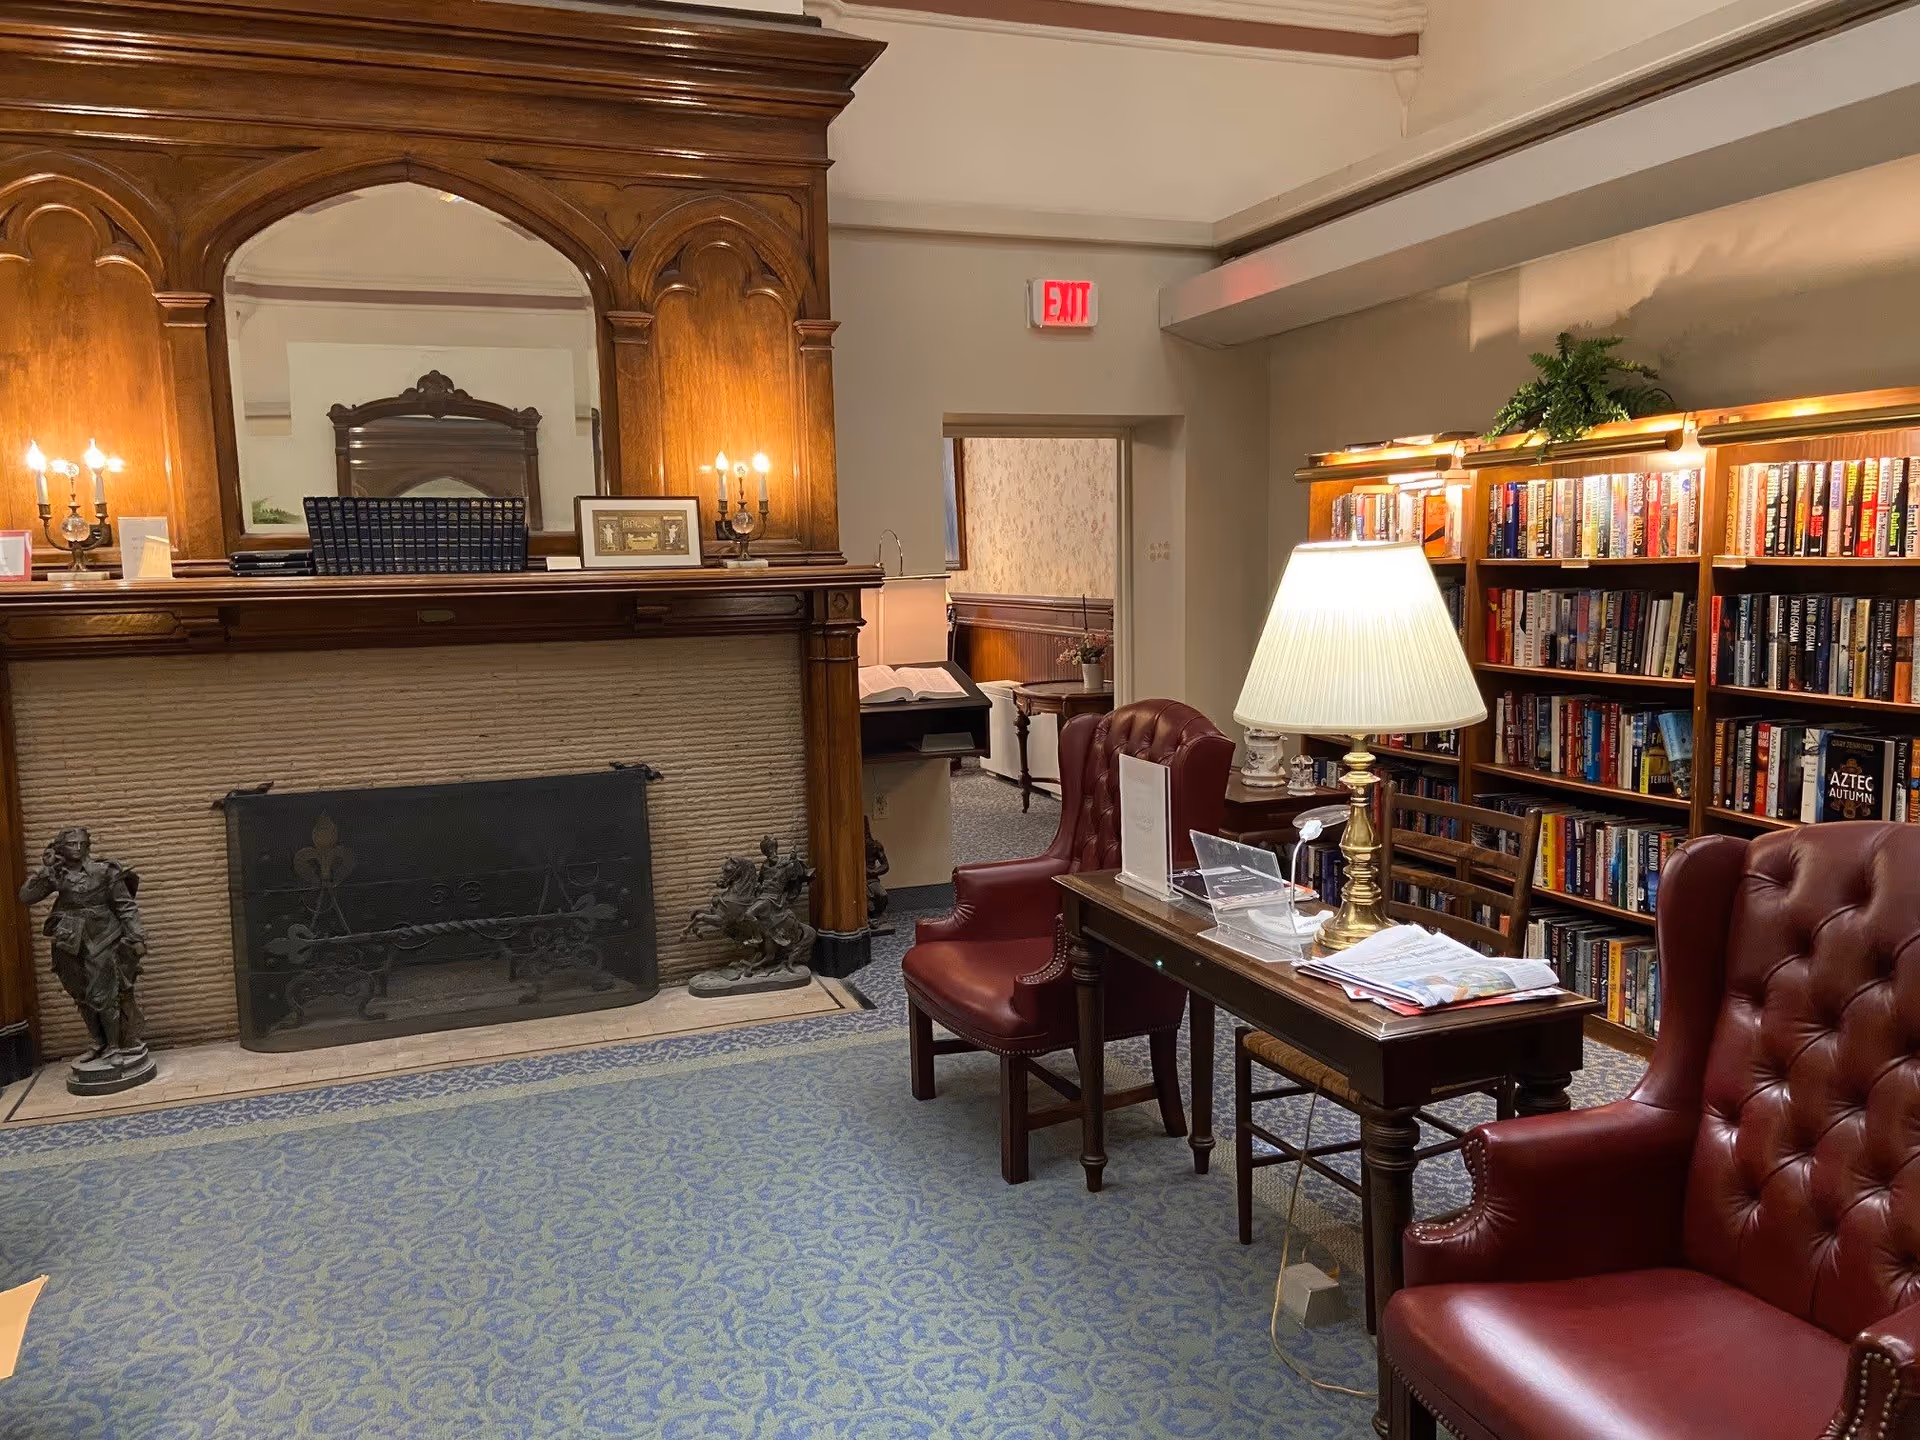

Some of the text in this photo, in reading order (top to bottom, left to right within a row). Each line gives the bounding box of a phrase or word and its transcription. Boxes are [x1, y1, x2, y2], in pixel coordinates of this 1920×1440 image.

[1044, 281, 1090, 322] EXIT
[1860, 460, 1879, 542] Griffin Hostage
[1909, 504, 1919, 528] Secret
[1877, 524, 1885, 551] Murderers
[1890, 511, 1900, 546] Outlaws
[1907, 529, 1918, 552] Honor
[1791, 600, 1800, 615] JOHN
[1789, 615, 1800, 643] GRISHAM
[1805, 598, 1818, 652] JOHN GRISHAM
[1715, 722, 1724, 735] TONY
[1744, 725, 1753, 738] TONY
[1770, 730, 1778, 750] TAMI
[1847, 741, 1874, 752] JENNINGS
[1897, 758, 1906, 779] TARGET
[1650, 775, 1670, 784] TERMI
[1830, 771, 1874, 792] AZTEC
[1829, 788, 1873, 804] AUTUMN
